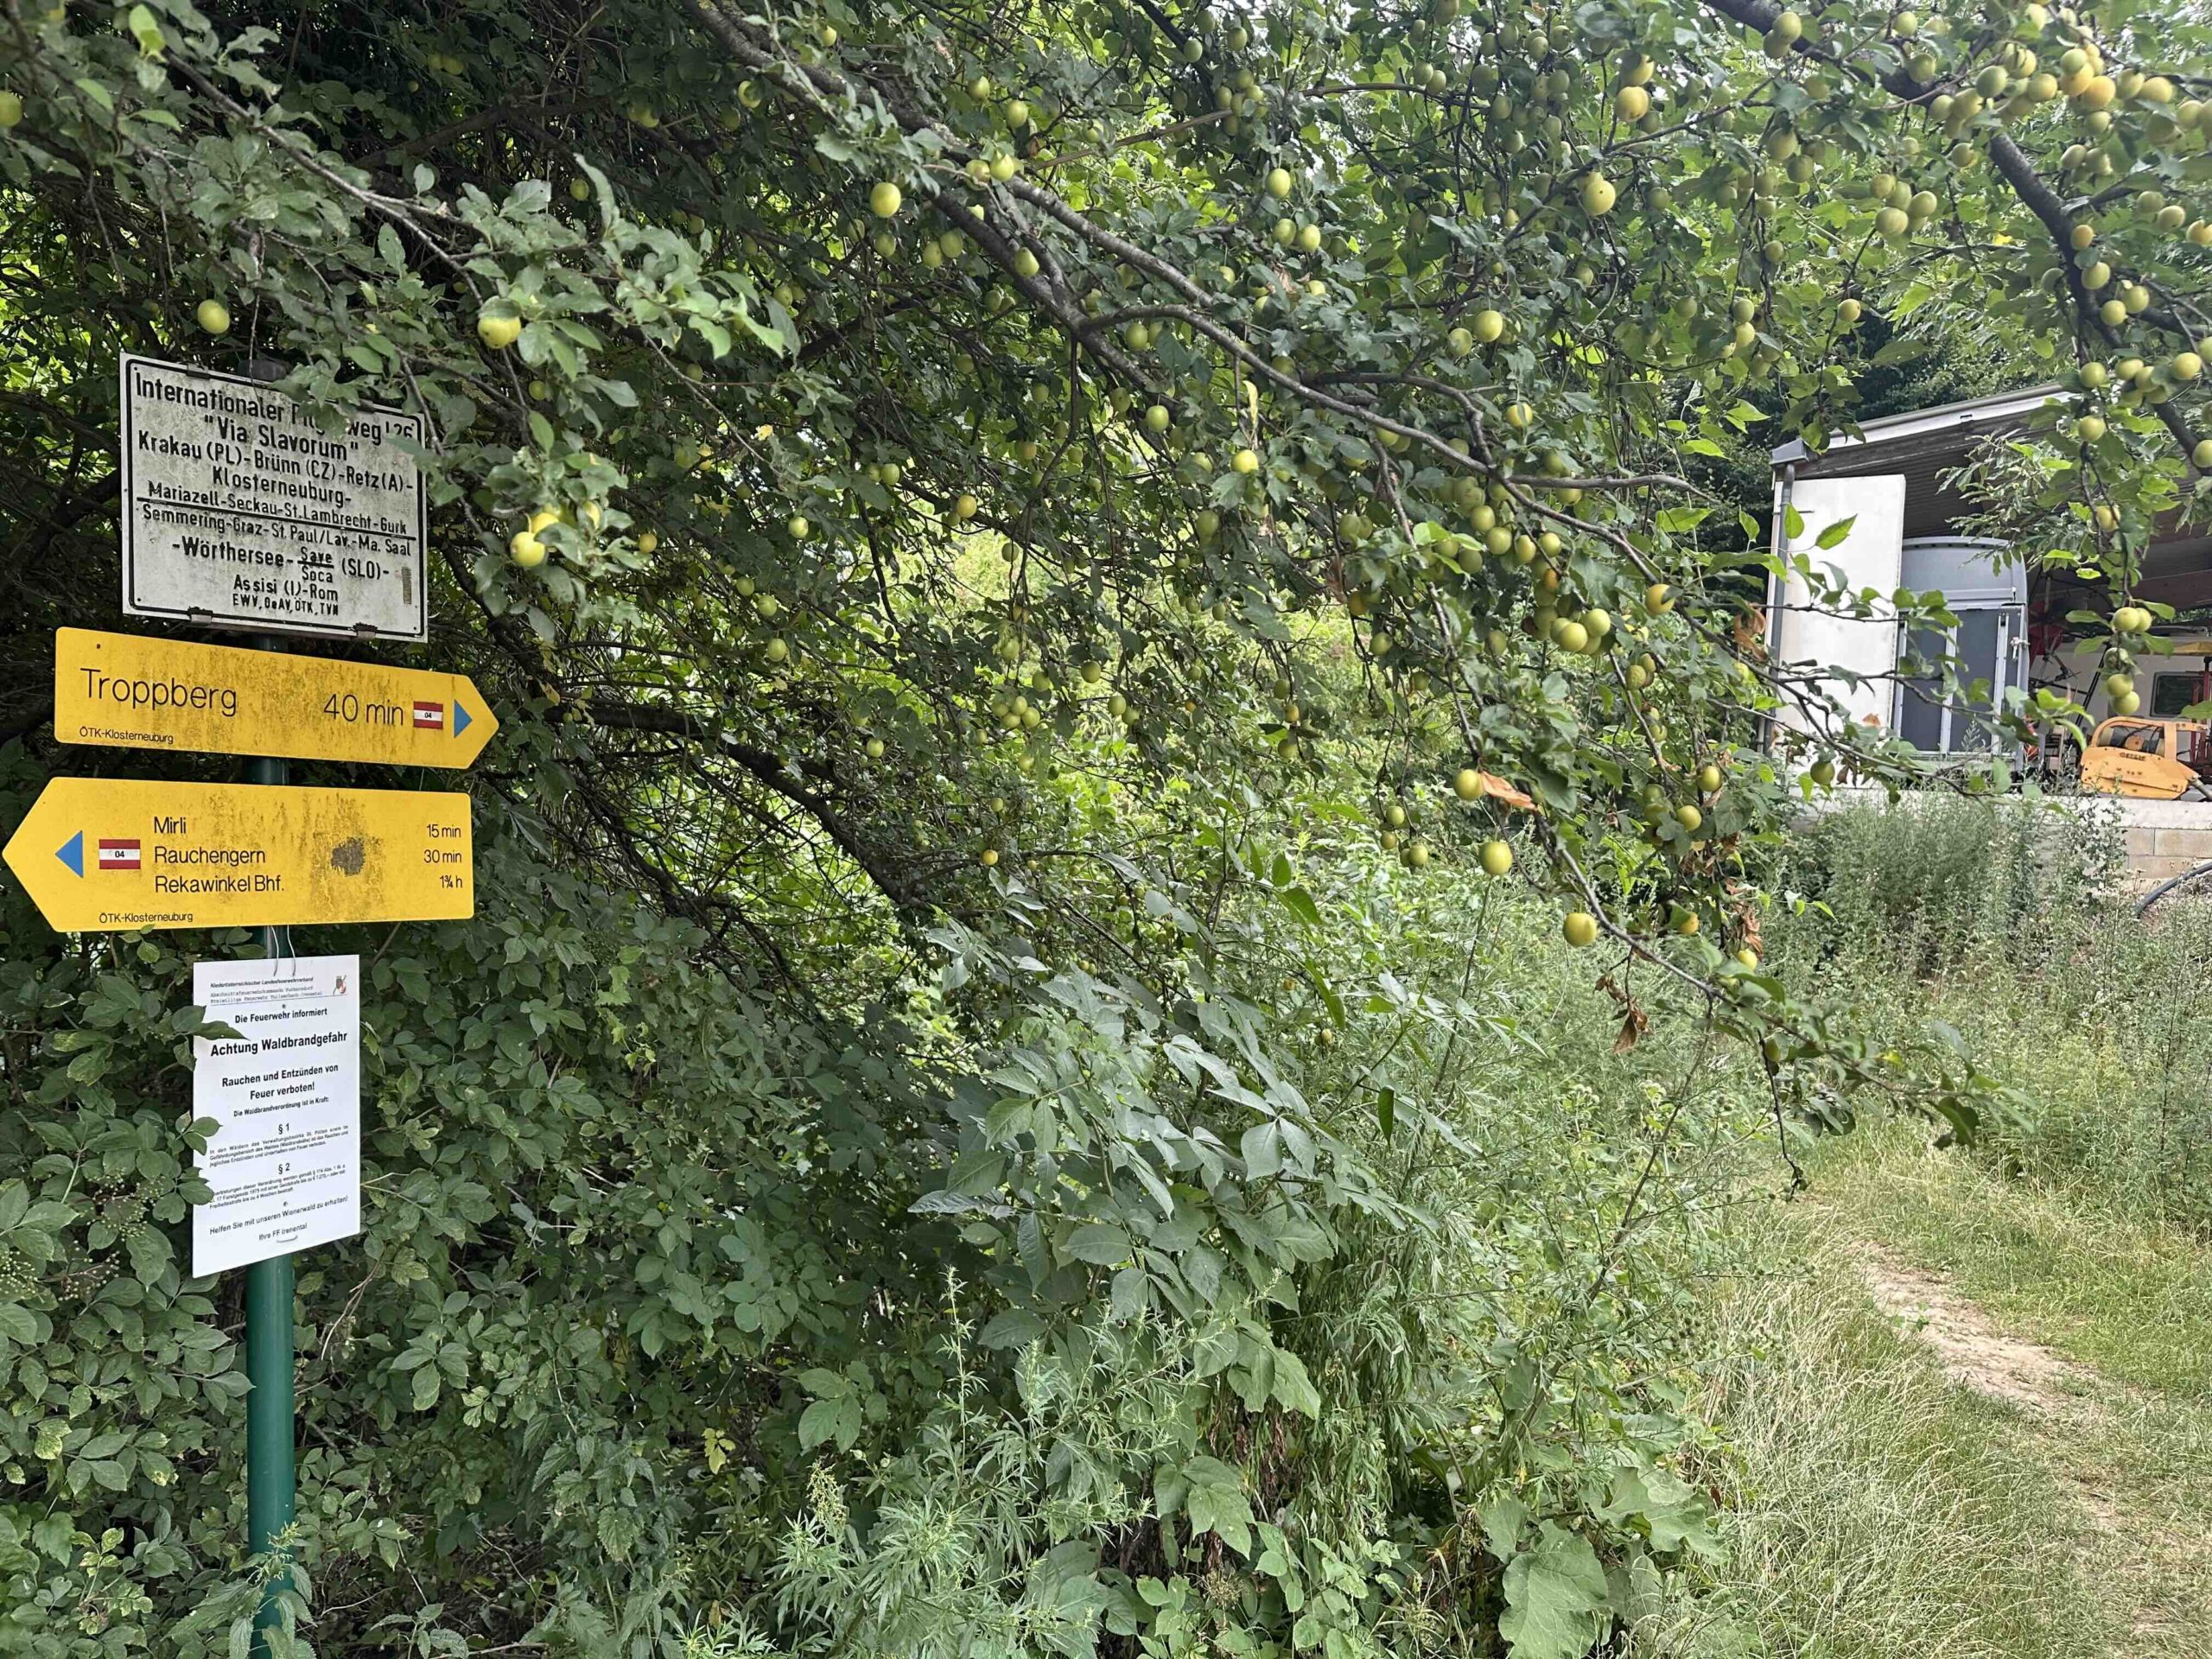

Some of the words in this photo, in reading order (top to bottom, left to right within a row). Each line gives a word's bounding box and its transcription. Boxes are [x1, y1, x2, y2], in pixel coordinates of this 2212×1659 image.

[136, 372, 284, 422] Internationaler
[138, 429, 202, 460] Krakau
[213, 465, 352, 509] Klosterneuburg-
[300, 546, 333, 563] Save
[385, 538, 411, 556] Saal
[301, 565, 334, 583] Soca
[233, 574, 276, 594] Assisi
[79, 667, 237, 717] Troppberg
[323, 694, 359, 722] 40
[365, 698, 404, 726] min
[79, 725, 174, 745] ÖTK-Klosterneuburg
[154, 816, 187, 835] Mirli
[426, 823, 440, 838] 15
[442, 823, 461, 838] min
[155, 845, 266, 867] Rauchengern
[423, 849, 441, 863] 30
[442, 849, 462, 863] min
[155, 874, 251, 893] Rekawinkel
[254, 874, 284, 892] Bhf.
[455, 874, 463, 888] h
[99, 912, 193, 924] ÖTK-Klosterneuburg
[235, 1014, 248, 1024] Die
[250, 1012, 290, 1022] Feuerwehr
[292, 1007, 327, 1018] informiert
[210, 1043, 258, 1057] Achtung
[261, 1031, 347, 1051] Waldbrandgefahr
[221, 1074, 261, 1088] Rauchen
[263, 1071, 279, 1082] und
[281, 1066, 323, 1080] Entzünden
[325, 1064, 339, 1073] von
[250, 1089, 275, 1100] Feuer
[276, 1082, 315, 1096] verboten!
[244, 1101, 302, 1116] Waldbrandverordnung
[278, 1123, 283, 1135] §
[285, 1122, 289, 1132] 1
[278, 1163, 283, 1175] §
[285, 1162, 290, 1172] 2
[209, 1224, 232, 1236] Helfen
[232, 1220, 244, 1229] Sie
[245, 1217, 256, 1227] mit
[282, 1203, 316, 1218] Wienerwald
[258, 1231, 271, 1241] Ihre
[272, 1229, 281, 1237] FF
